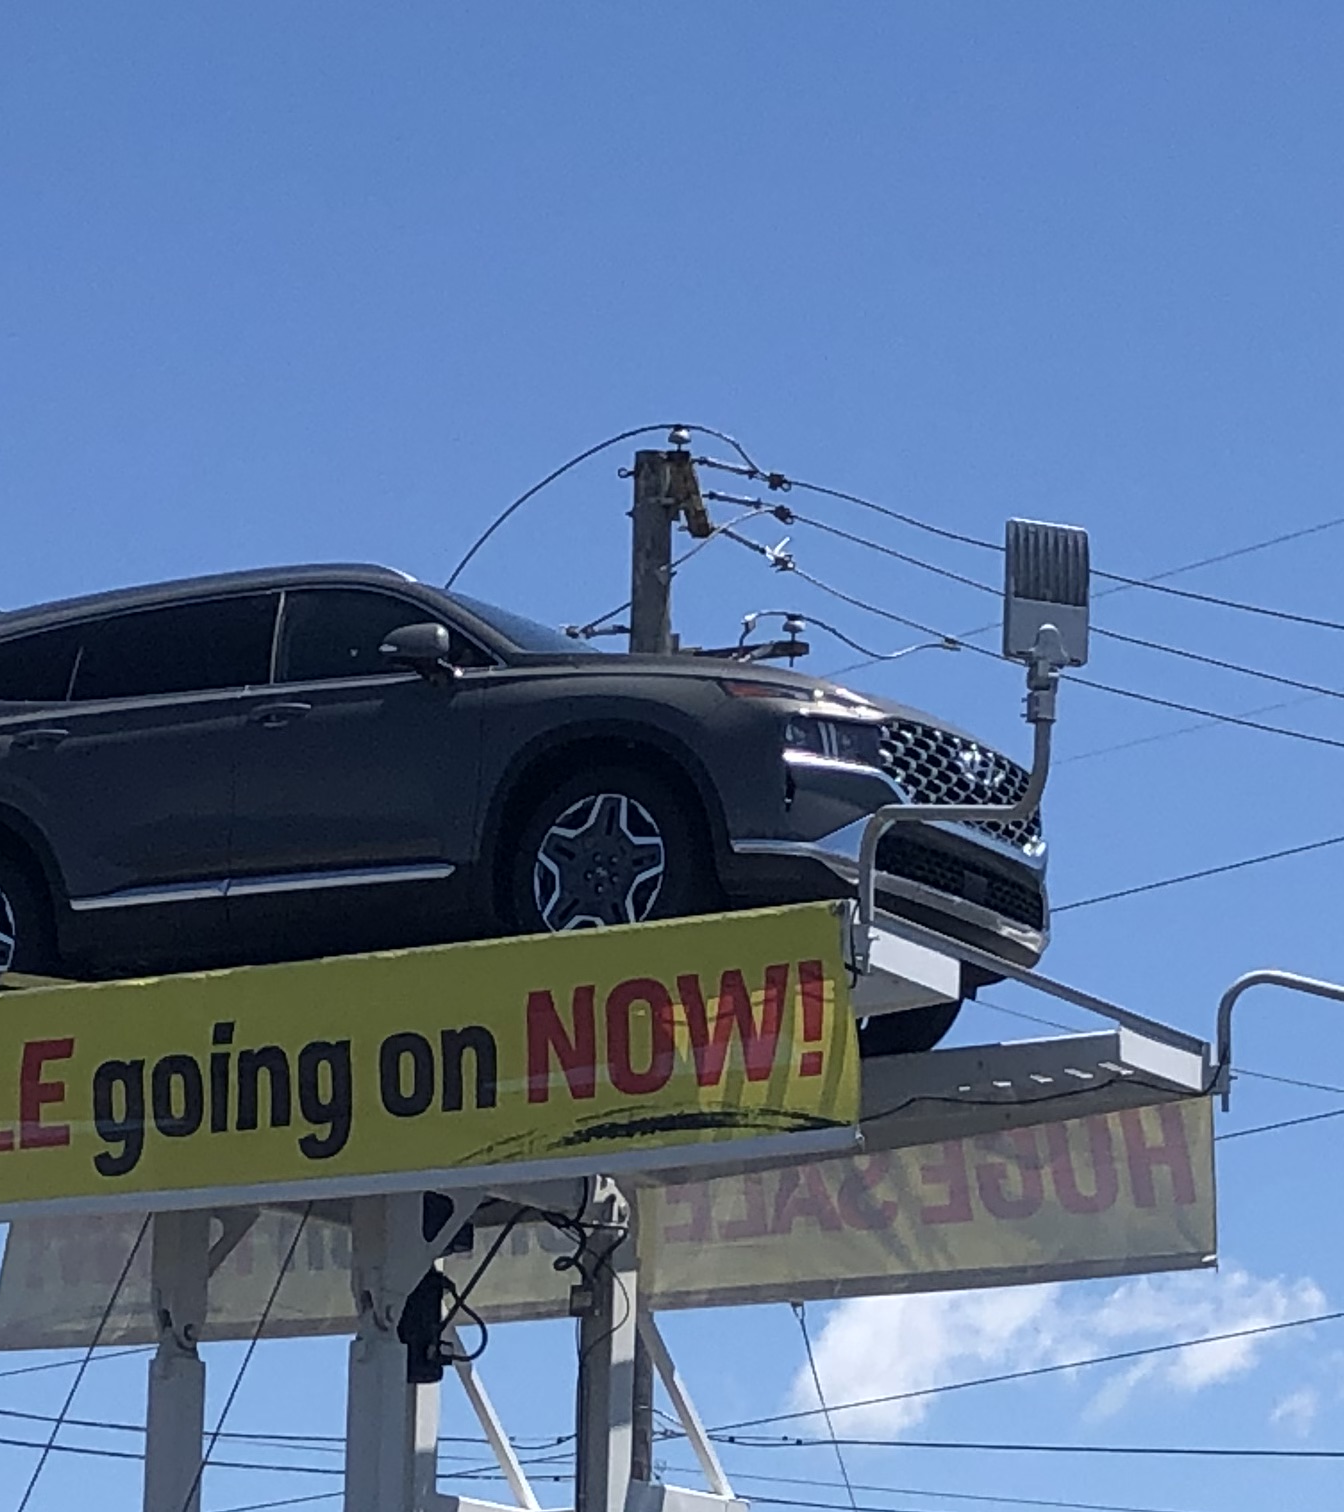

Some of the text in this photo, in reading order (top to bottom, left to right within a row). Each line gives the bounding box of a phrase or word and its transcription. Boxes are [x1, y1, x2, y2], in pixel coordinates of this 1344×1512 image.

[93, 1022, 350, 1177] going
[380, 1024, 496, 1119] on
[525, 960, 824, 1104] NOW!
